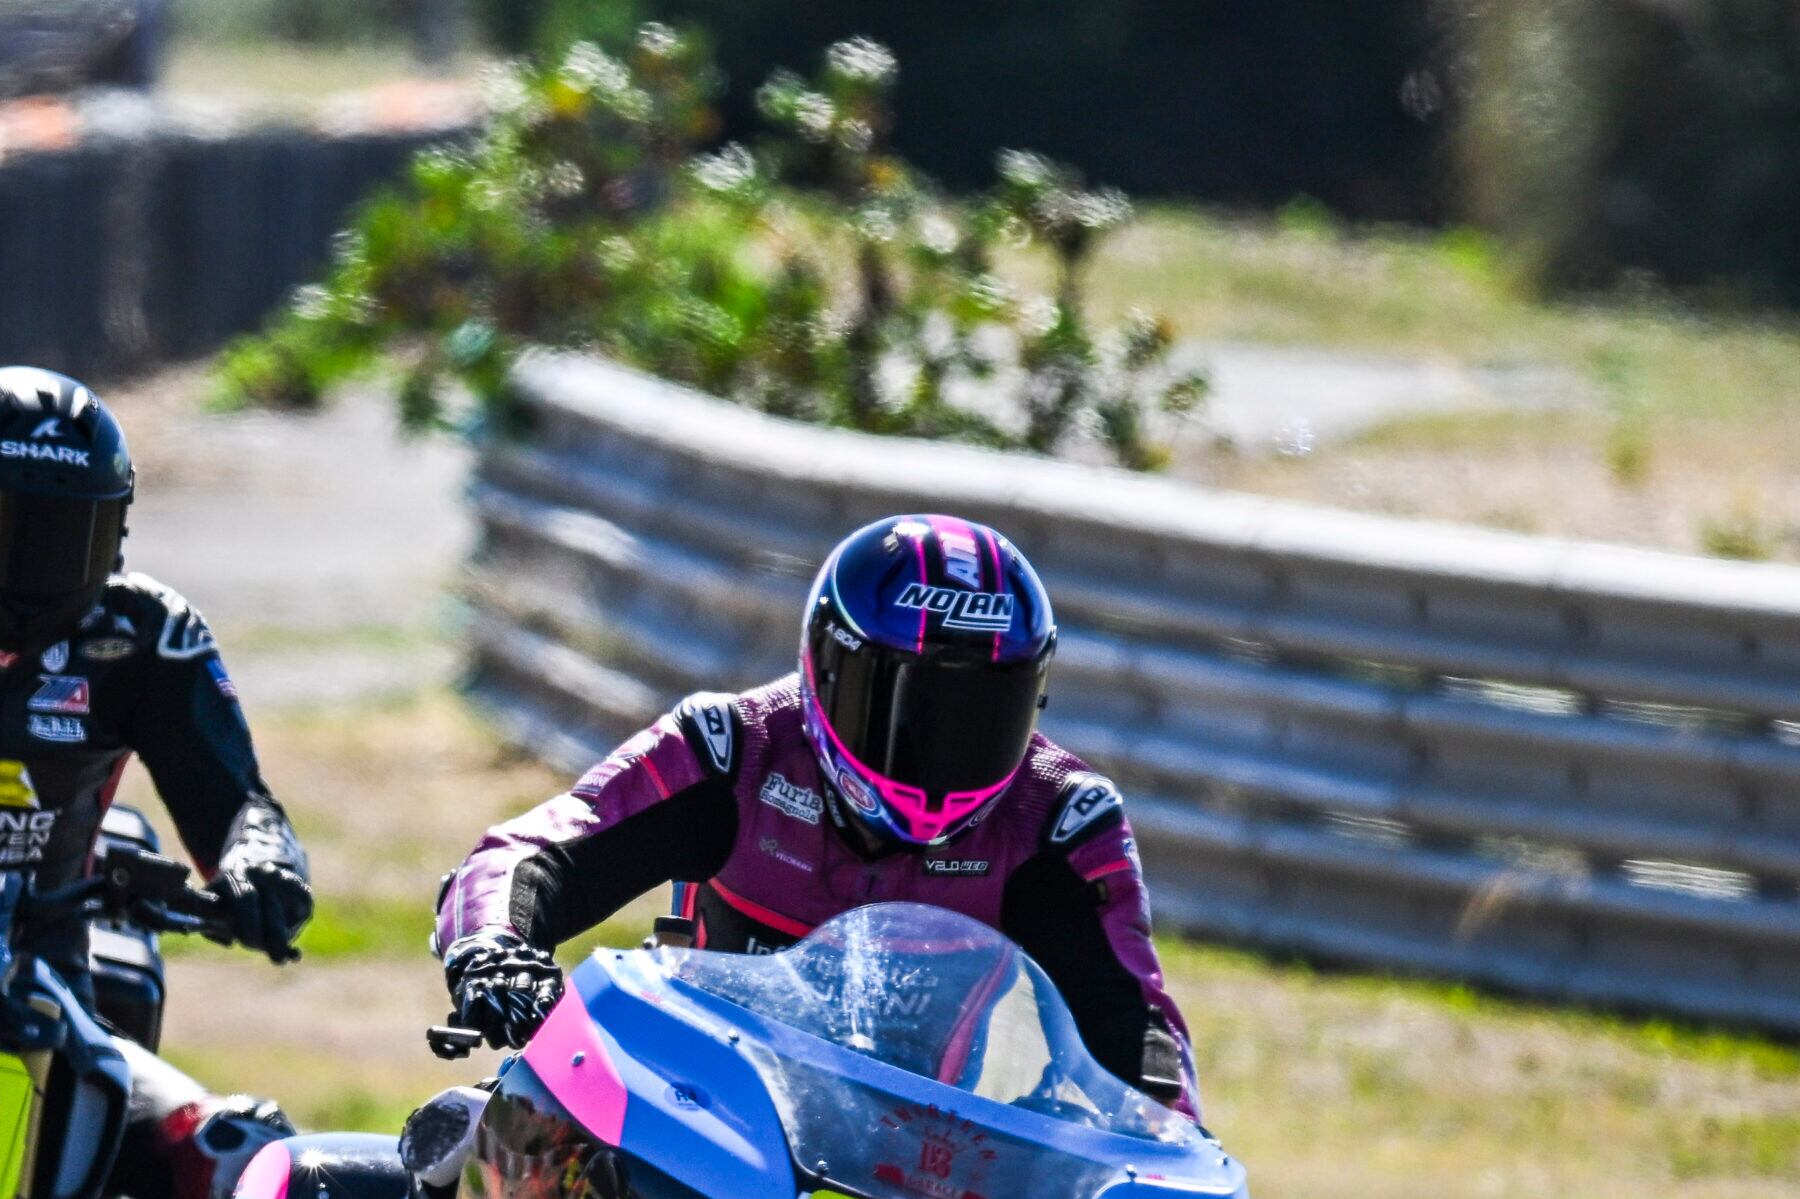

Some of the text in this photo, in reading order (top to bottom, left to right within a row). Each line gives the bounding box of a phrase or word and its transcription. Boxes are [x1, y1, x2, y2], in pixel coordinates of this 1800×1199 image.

[0, 440, 90, 468] SHARK
[894, 583, 1014, 632] NOLAN
[766, 773, 823, 812] Furia
